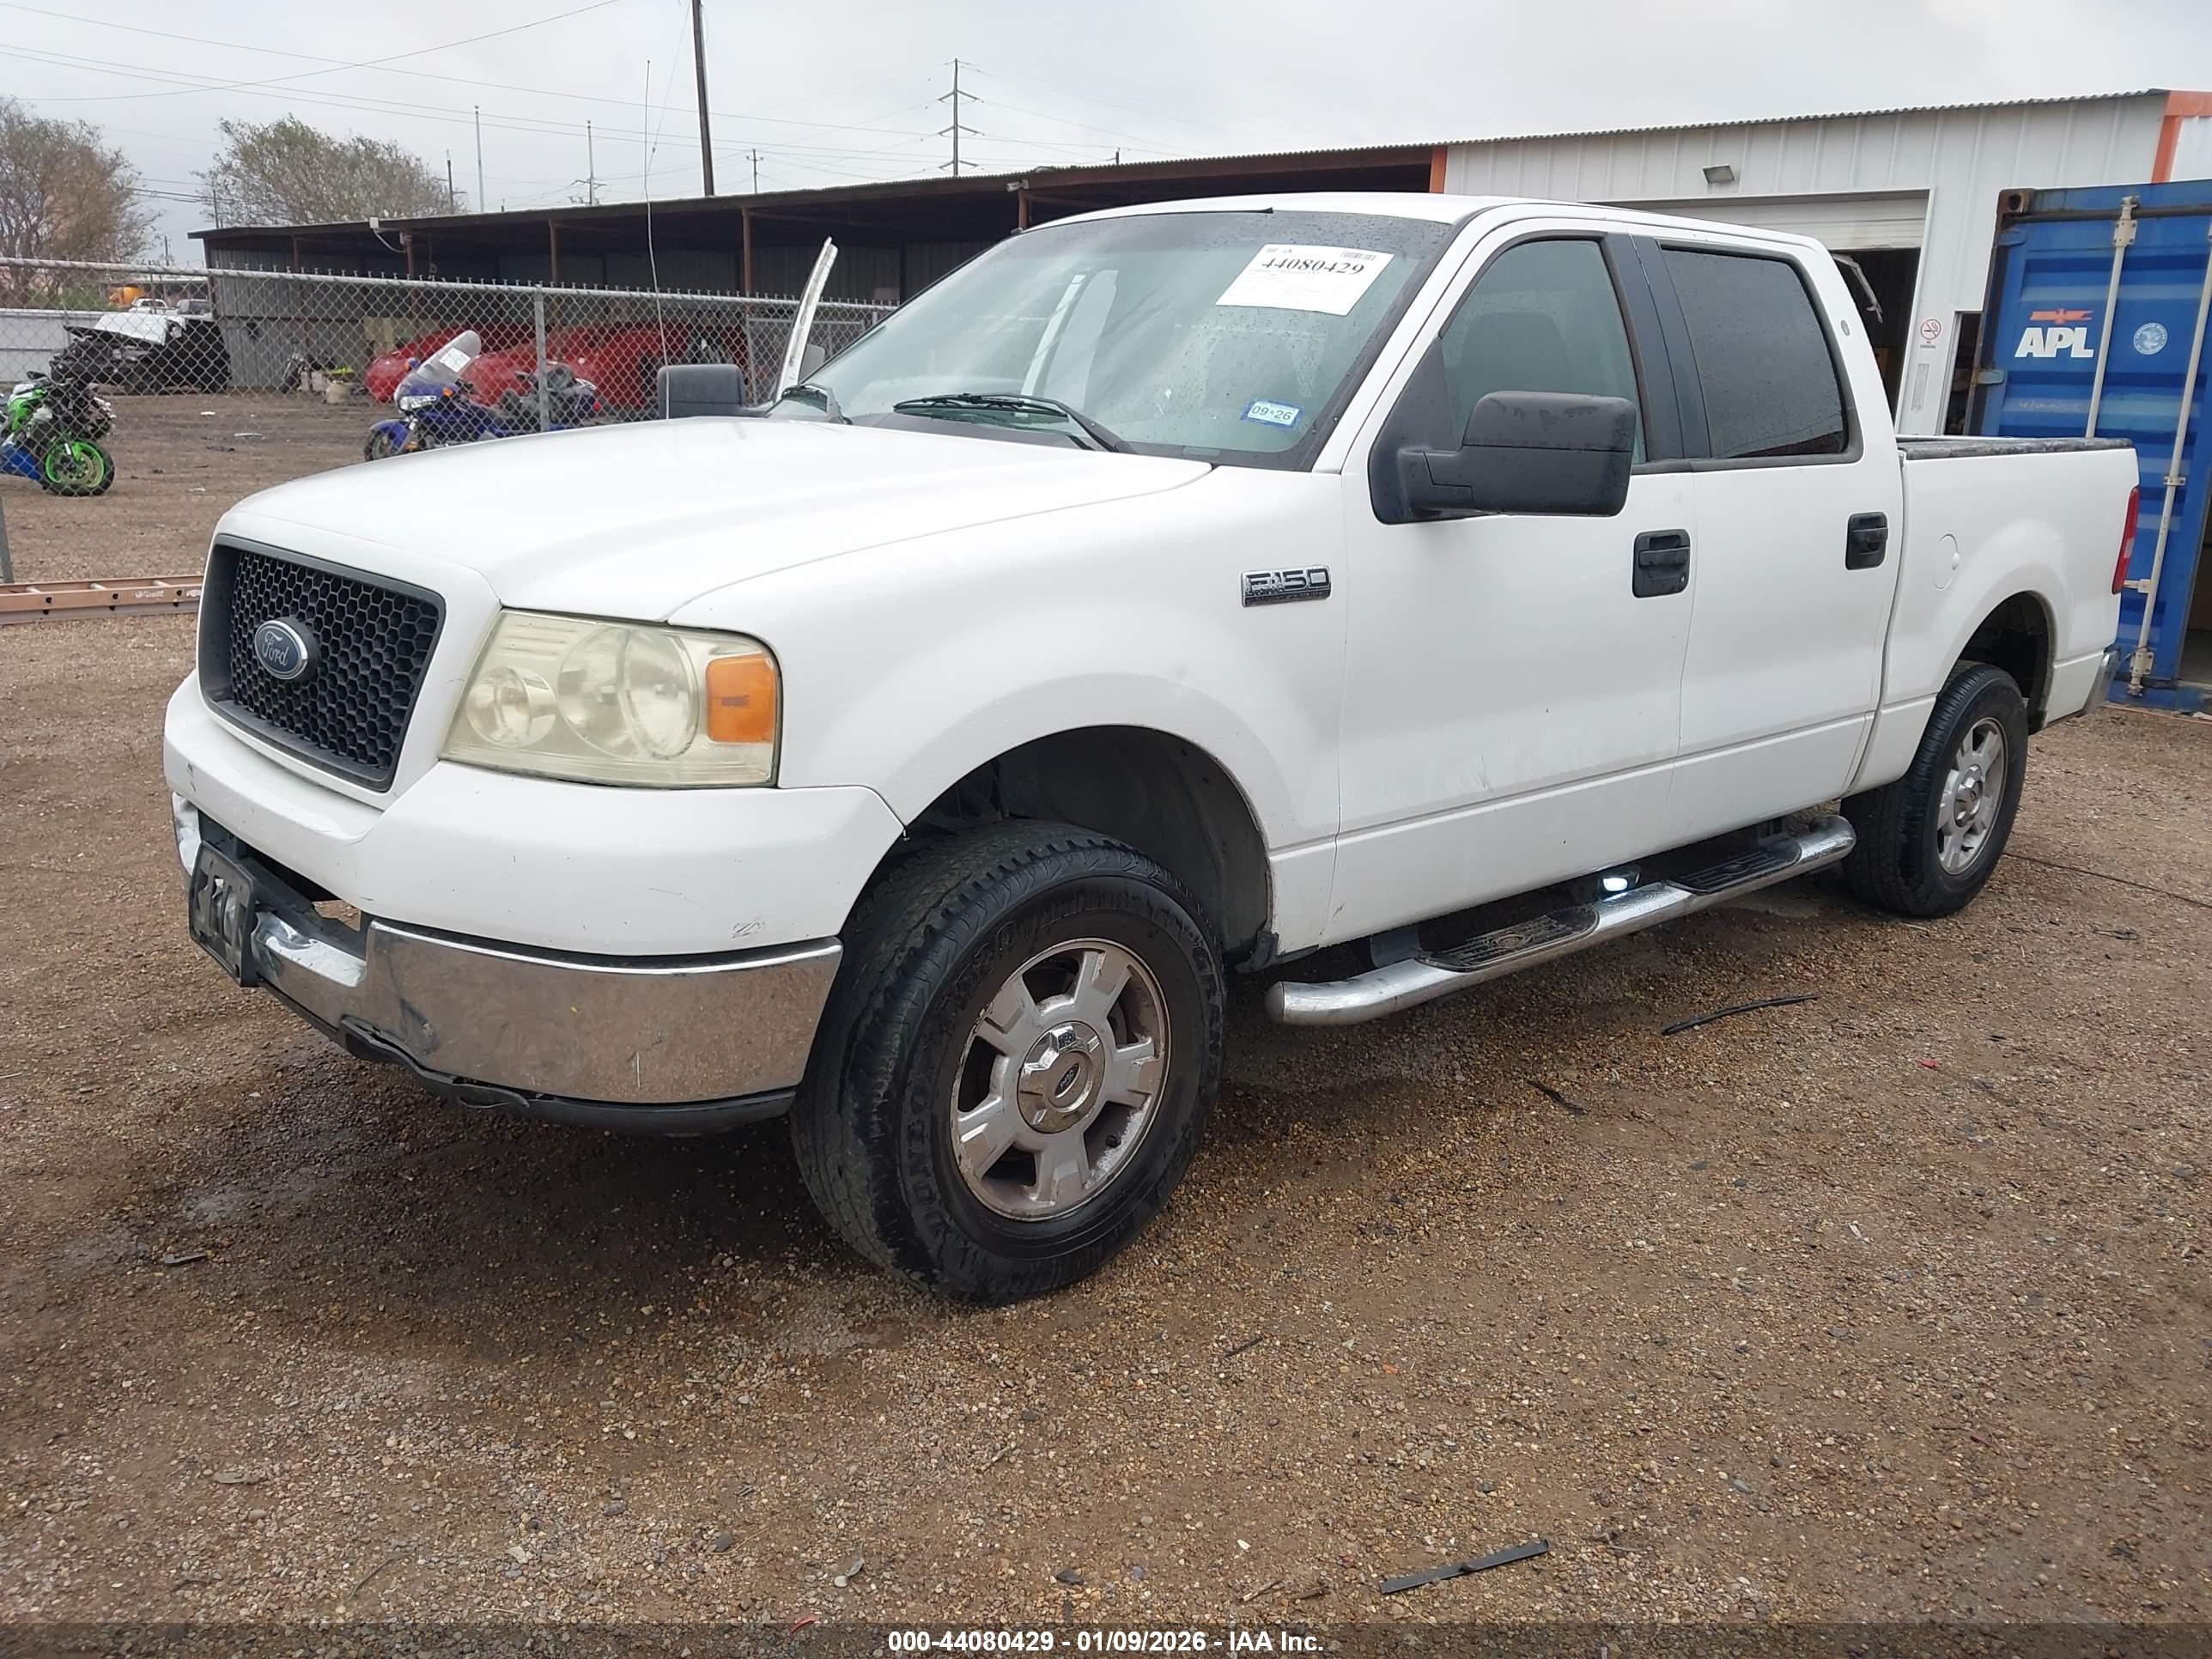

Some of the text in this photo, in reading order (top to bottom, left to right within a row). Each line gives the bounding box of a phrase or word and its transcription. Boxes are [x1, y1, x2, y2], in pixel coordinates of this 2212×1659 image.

[1261, 257, 1364, 276] 44080429
[2014, 327, 2094, 359] APL
[1251, 405, 1292, 421] 09 26
[261, 631, 289, 666] Ford
